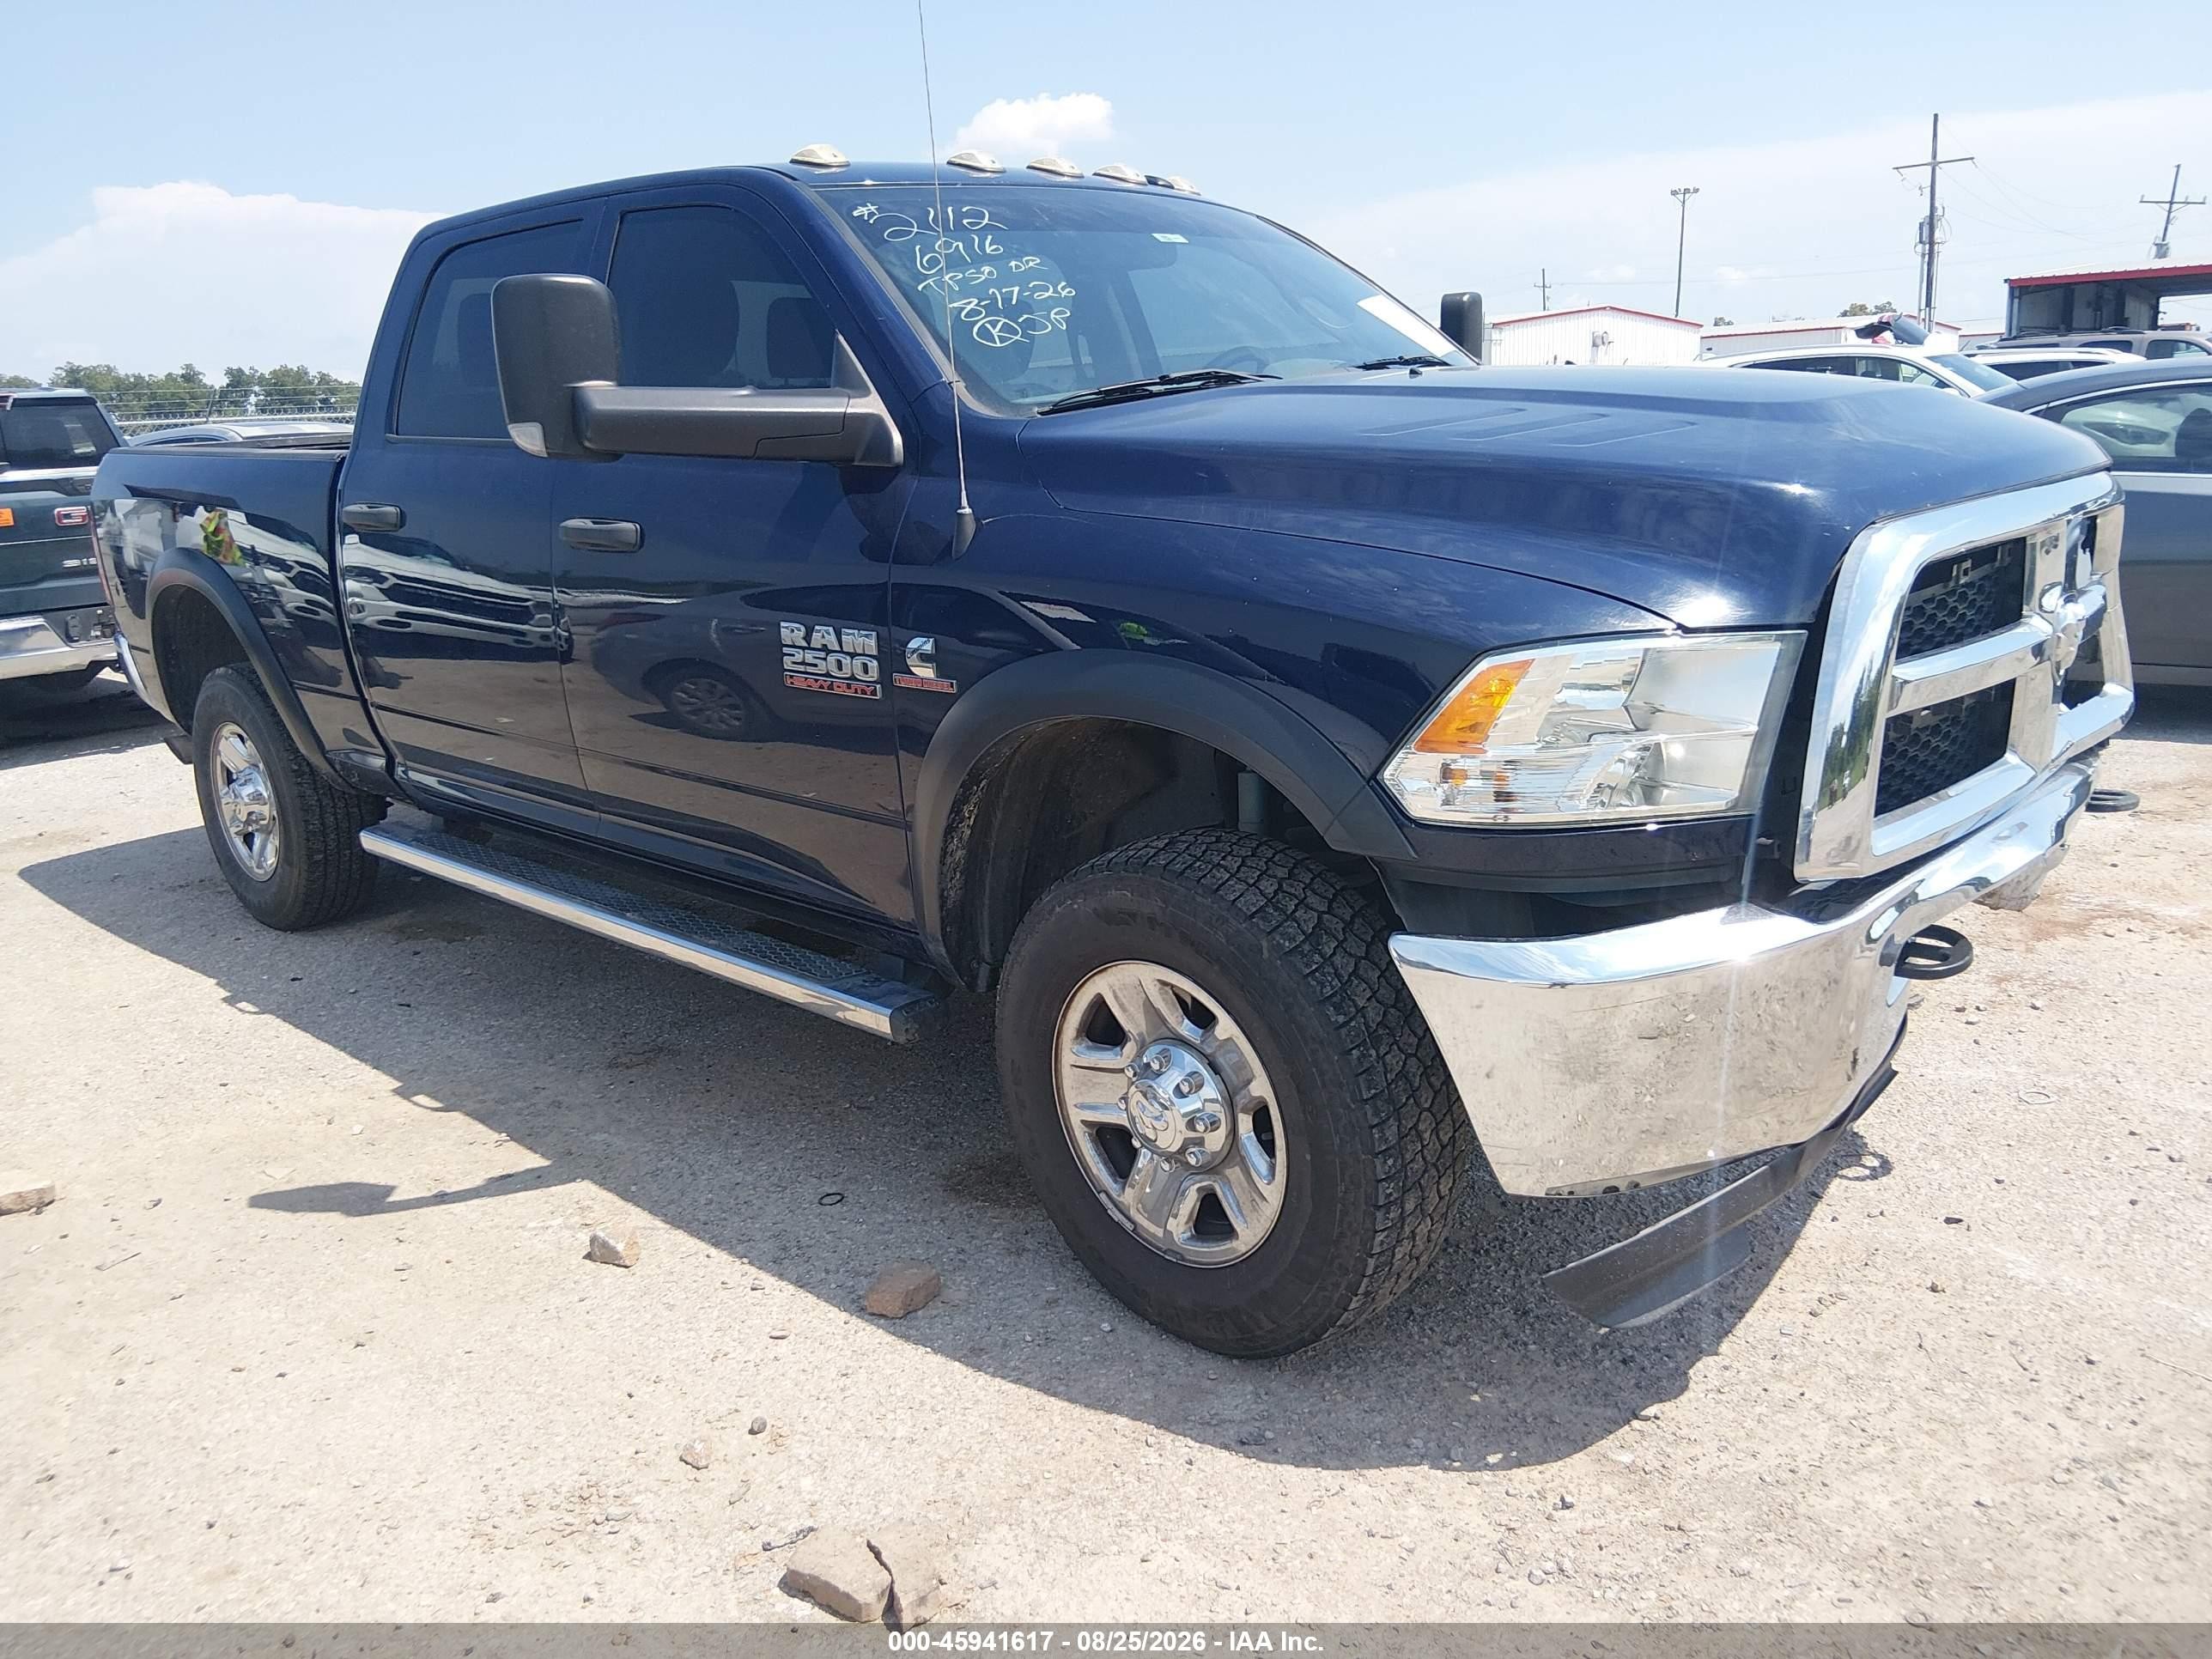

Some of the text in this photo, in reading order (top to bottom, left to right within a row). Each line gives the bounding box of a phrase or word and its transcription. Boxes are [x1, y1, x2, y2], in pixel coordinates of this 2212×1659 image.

[853, 204, 1008, 241] #2112
[915, 234, 1003, 274] 6916
[780, 621, 878, 655] RAM
[782, 647, 880, 682] 2500
[786, 676, 875, 696] HEAVY DUTY
